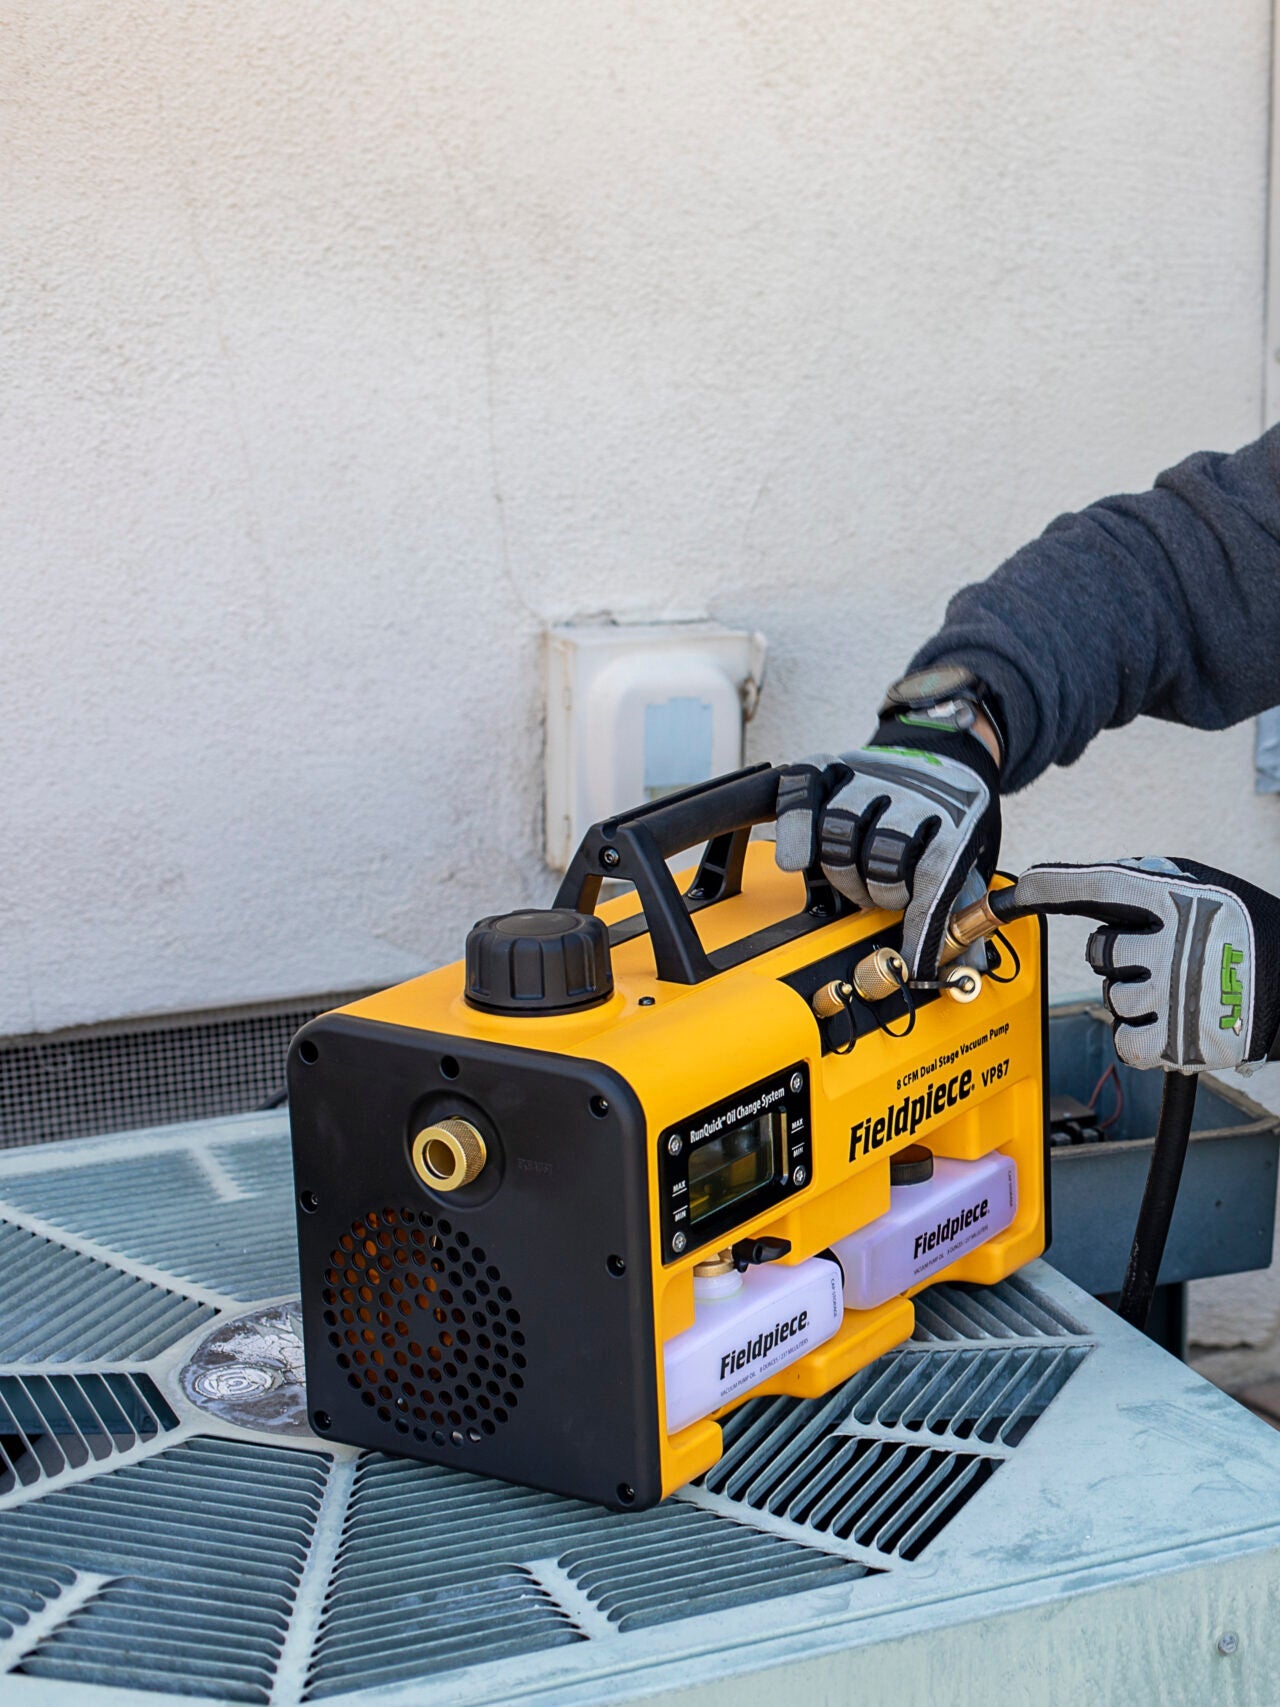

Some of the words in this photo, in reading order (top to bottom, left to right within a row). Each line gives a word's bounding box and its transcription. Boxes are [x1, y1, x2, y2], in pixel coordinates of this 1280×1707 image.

[1219, 943, 1244, 1034] LIFT
[896, 1079, 902, 1090] 8
[903, 1069, 919, 1086] CFM
[920, 1059, 937, 1078] Dual
[939, 1050, 959, 1068] Stage
[960, 1034, 988, 1055] Vacuum
[990, 1022, 1009, 1040] Pump
[726, 1109, 737, 1125] Oil
[737, 1100, 761, 1120] Change
[761, 1087, 785, 1108] System
[791, 1118, 804, 1129] MAX
[849, 1069, 973, 1163] Fieldpiece
[982, 1058, 1010, 1087] VP87
[672, 1180, 686, 1193] MAX
[674, 1210, 687, 1222] MIN
[913, 1199, 988, 1260] Fieldpiece
[720, 1310, 808, 1380] Fieldpiece
